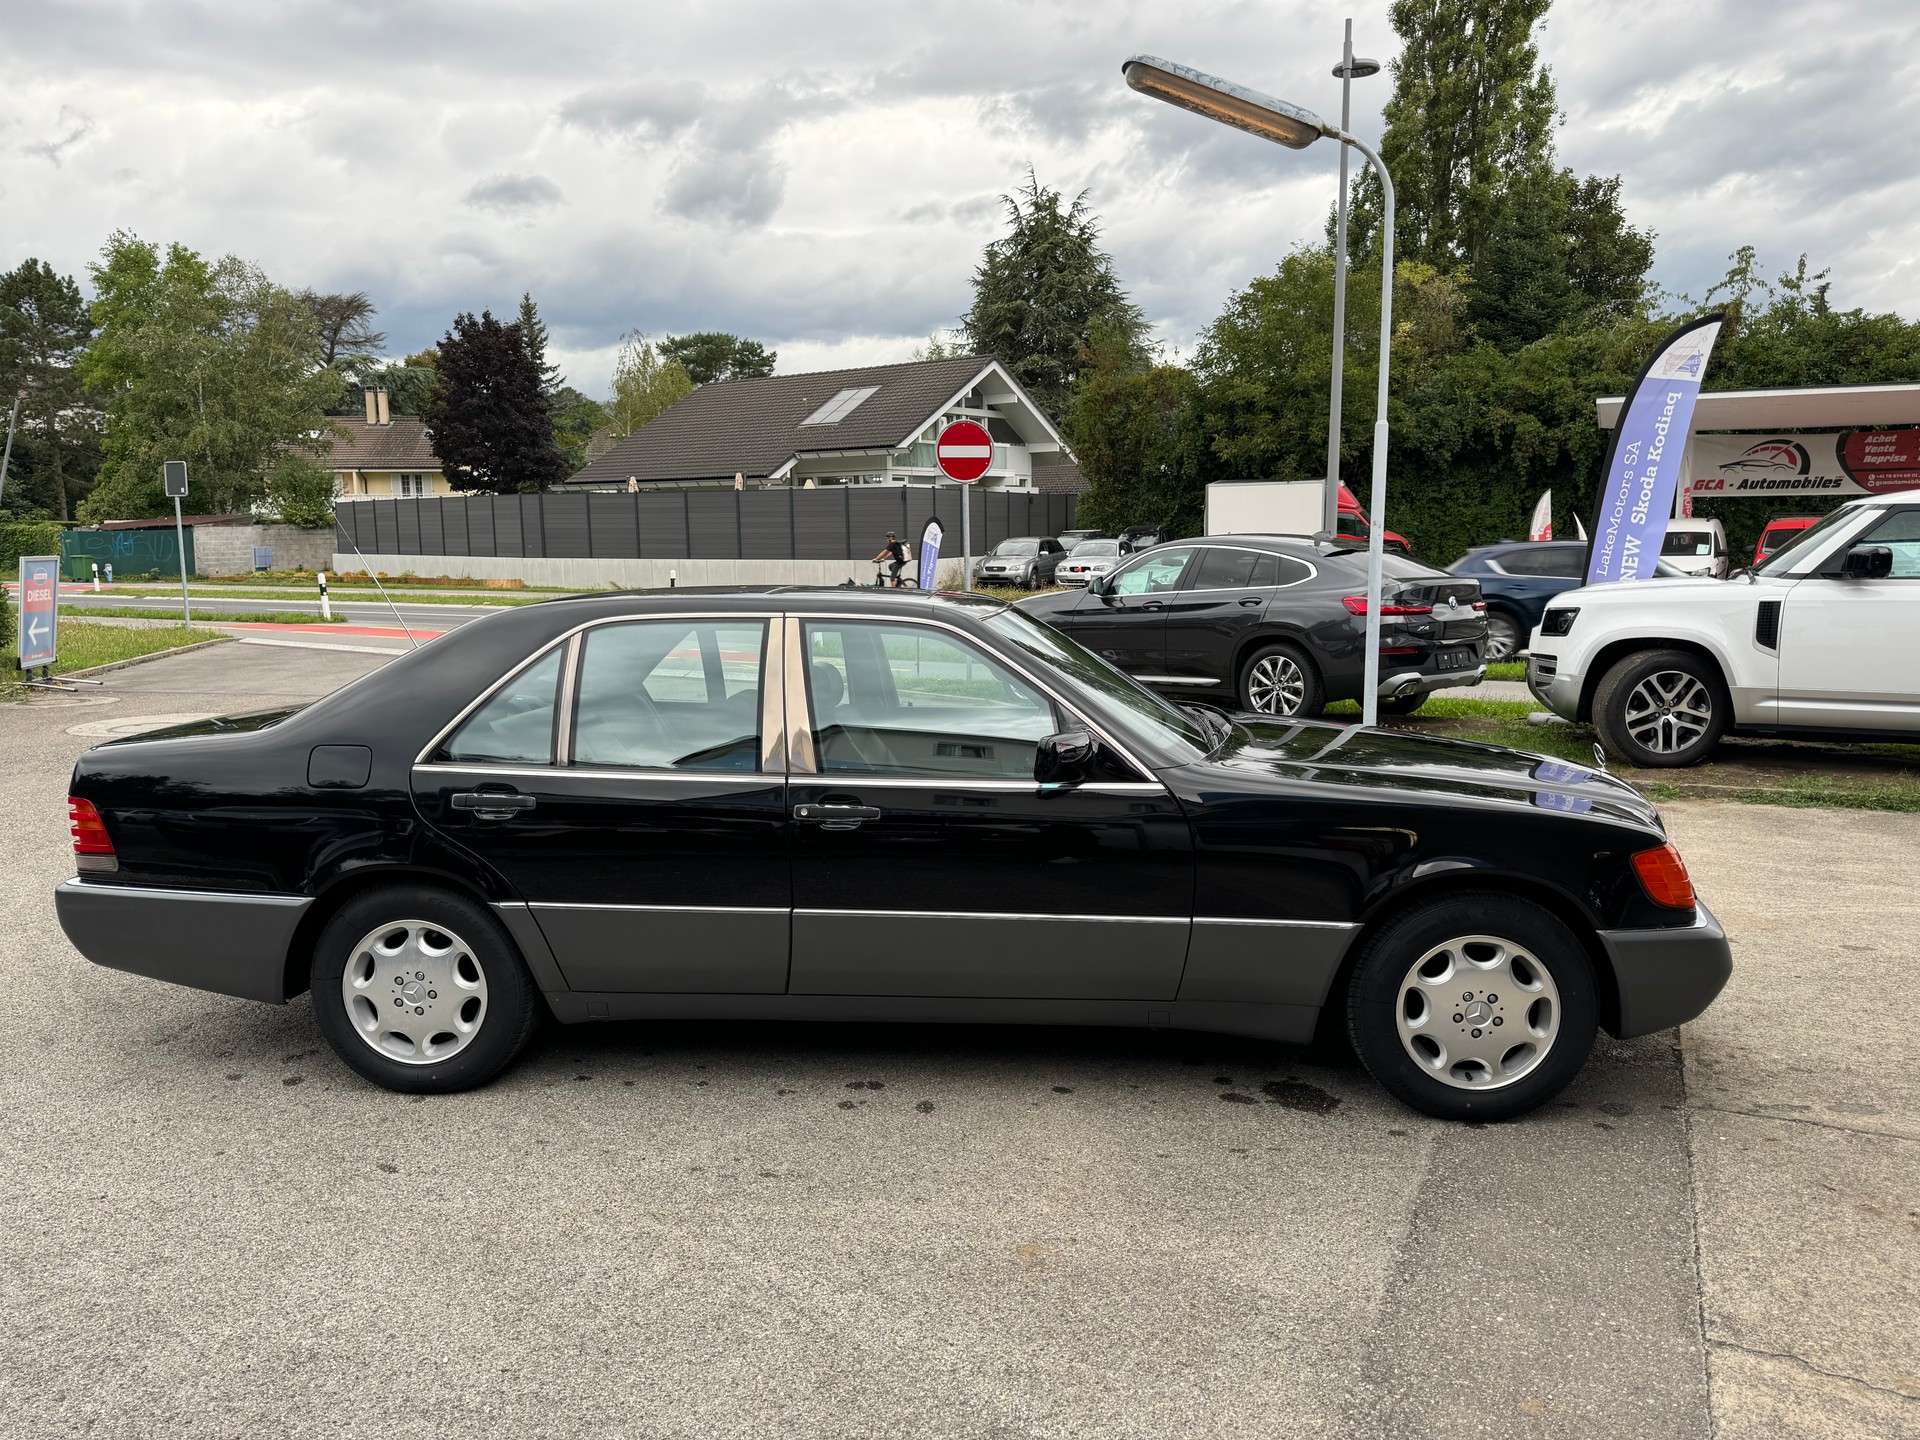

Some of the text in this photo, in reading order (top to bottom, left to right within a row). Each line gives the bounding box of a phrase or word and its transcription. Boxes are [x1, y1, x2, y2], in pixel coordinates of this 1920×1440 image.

[1864, 434, 1898, 443] Achat
[1865, 445, 1896, 453] Vente
[1863, 454, 1908, 464] Reprise
[1619, 391, 1682, 583] NEW Skoda Kodiaq
[1693, 479, 1725, 491] GCA
[1736, 476, 1844, 490] Automobiles
[1596, 440, 1642, 576] LakeMotors SA
[27, 588, 52, 602] DIESEL
